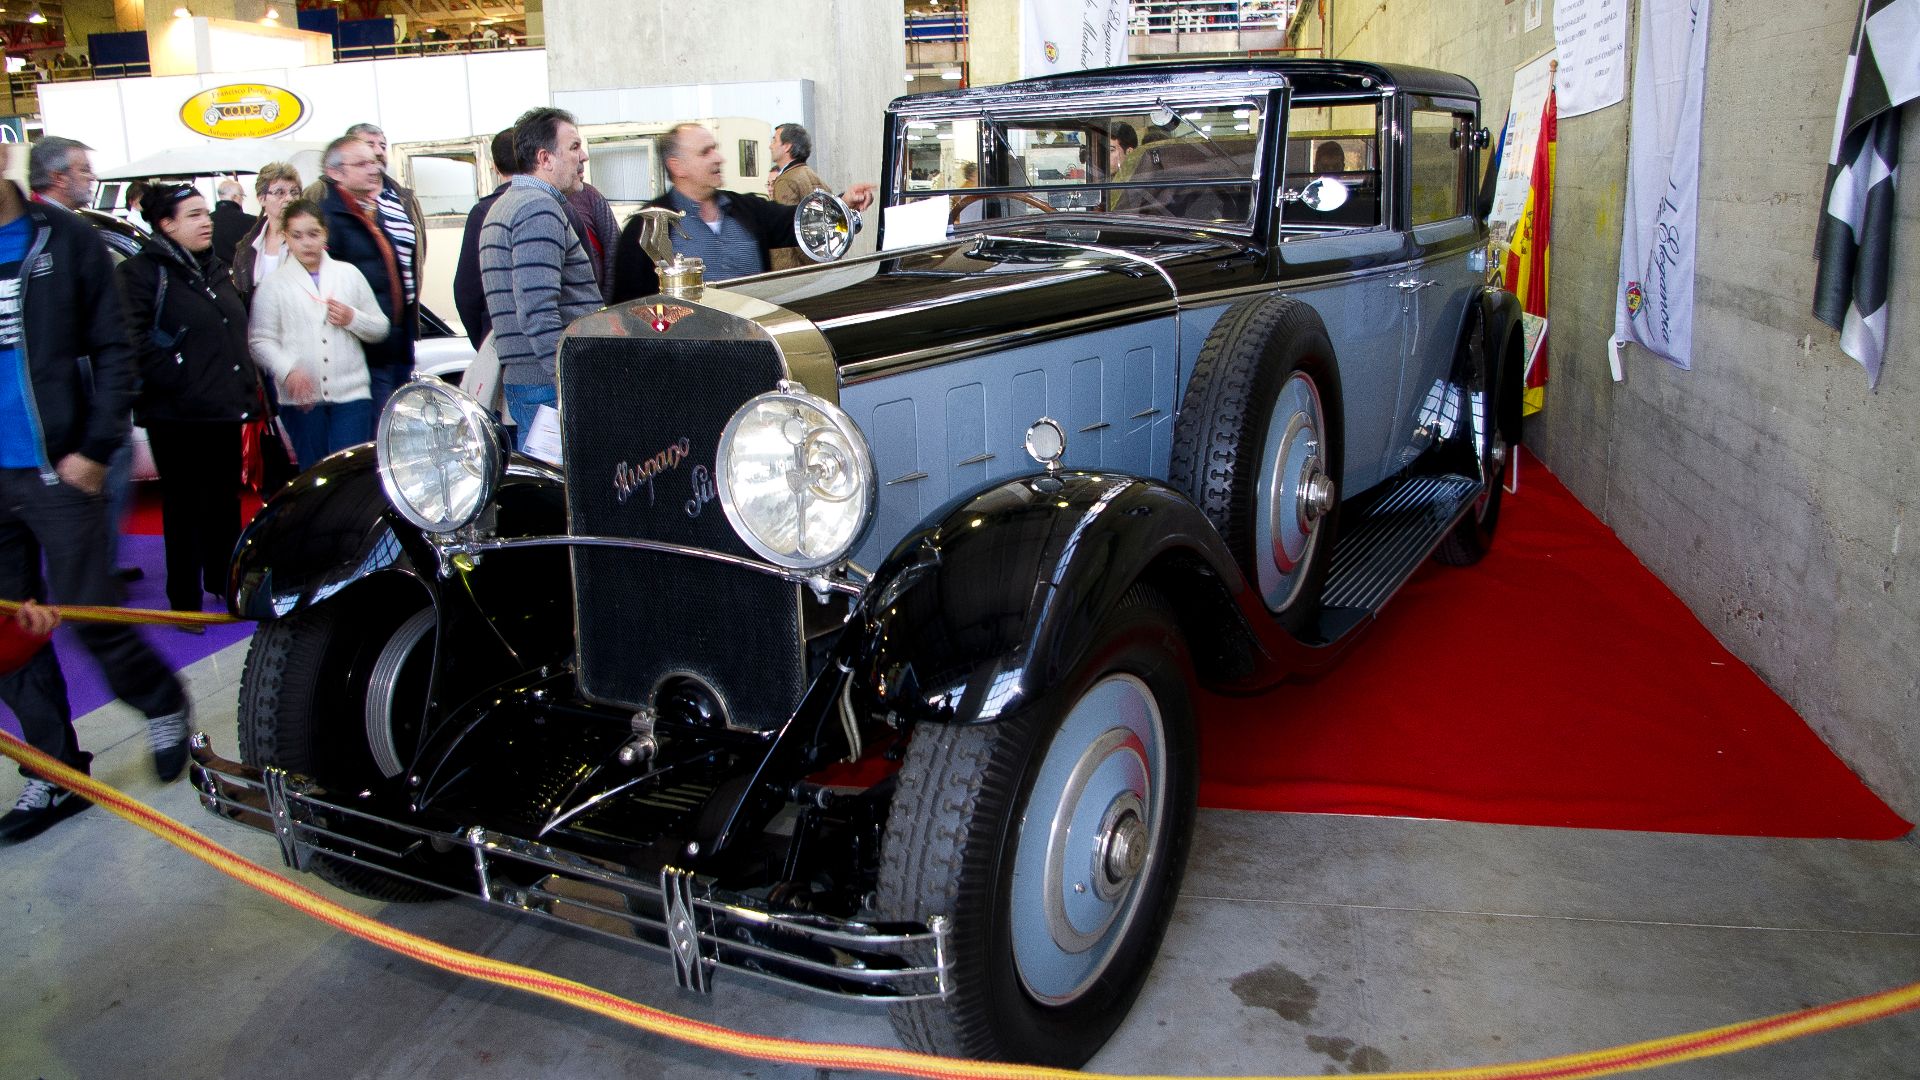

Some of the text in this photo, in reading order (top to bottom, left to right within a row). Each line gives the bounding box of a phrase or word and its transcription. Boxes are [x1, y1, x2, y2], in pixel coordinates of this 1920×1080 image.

[211, 87, 246, 99] Francisco
[1653, 222, 1681, 345] Elegancia
[613, 436, 691, 508] Hispano
